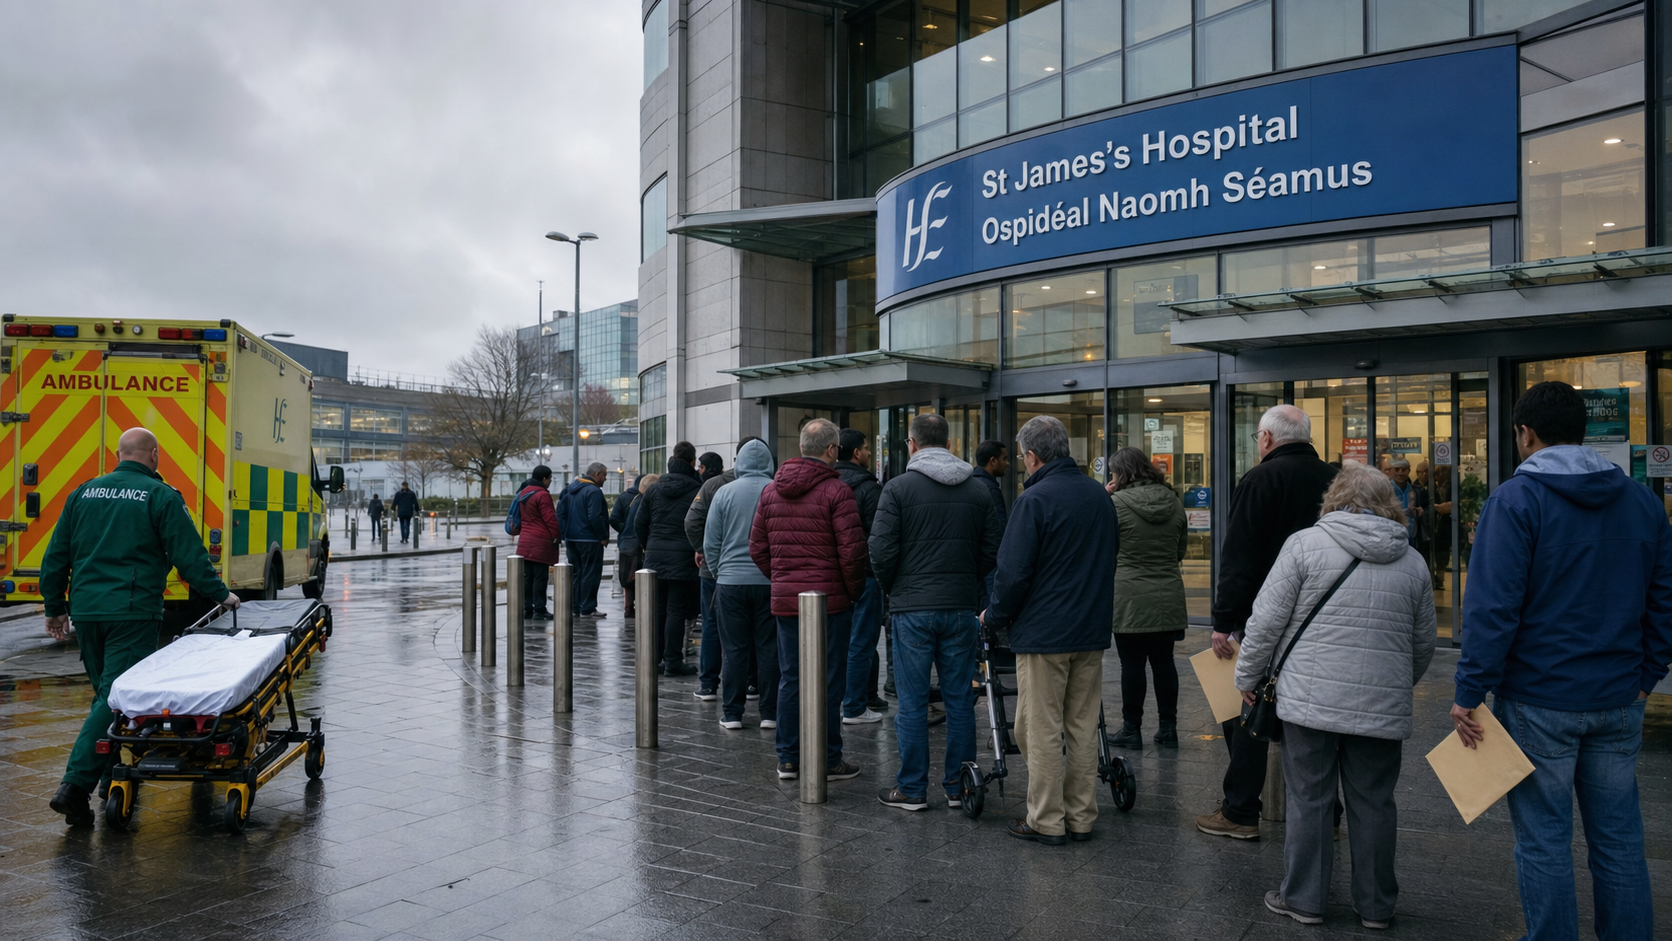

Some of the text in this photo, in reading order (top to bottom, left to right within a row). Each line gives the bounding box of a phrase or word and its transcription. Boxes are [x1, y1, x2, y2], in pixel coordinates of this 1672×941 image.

[981, 105, 1298, 199] St James's Hospital
[981, 161, 1374, 246] Ospidéal Naomh Séamus
[41, 374, 189, 392] AMBULANCE
[82, 487, 149, 501] AMBULANCE
